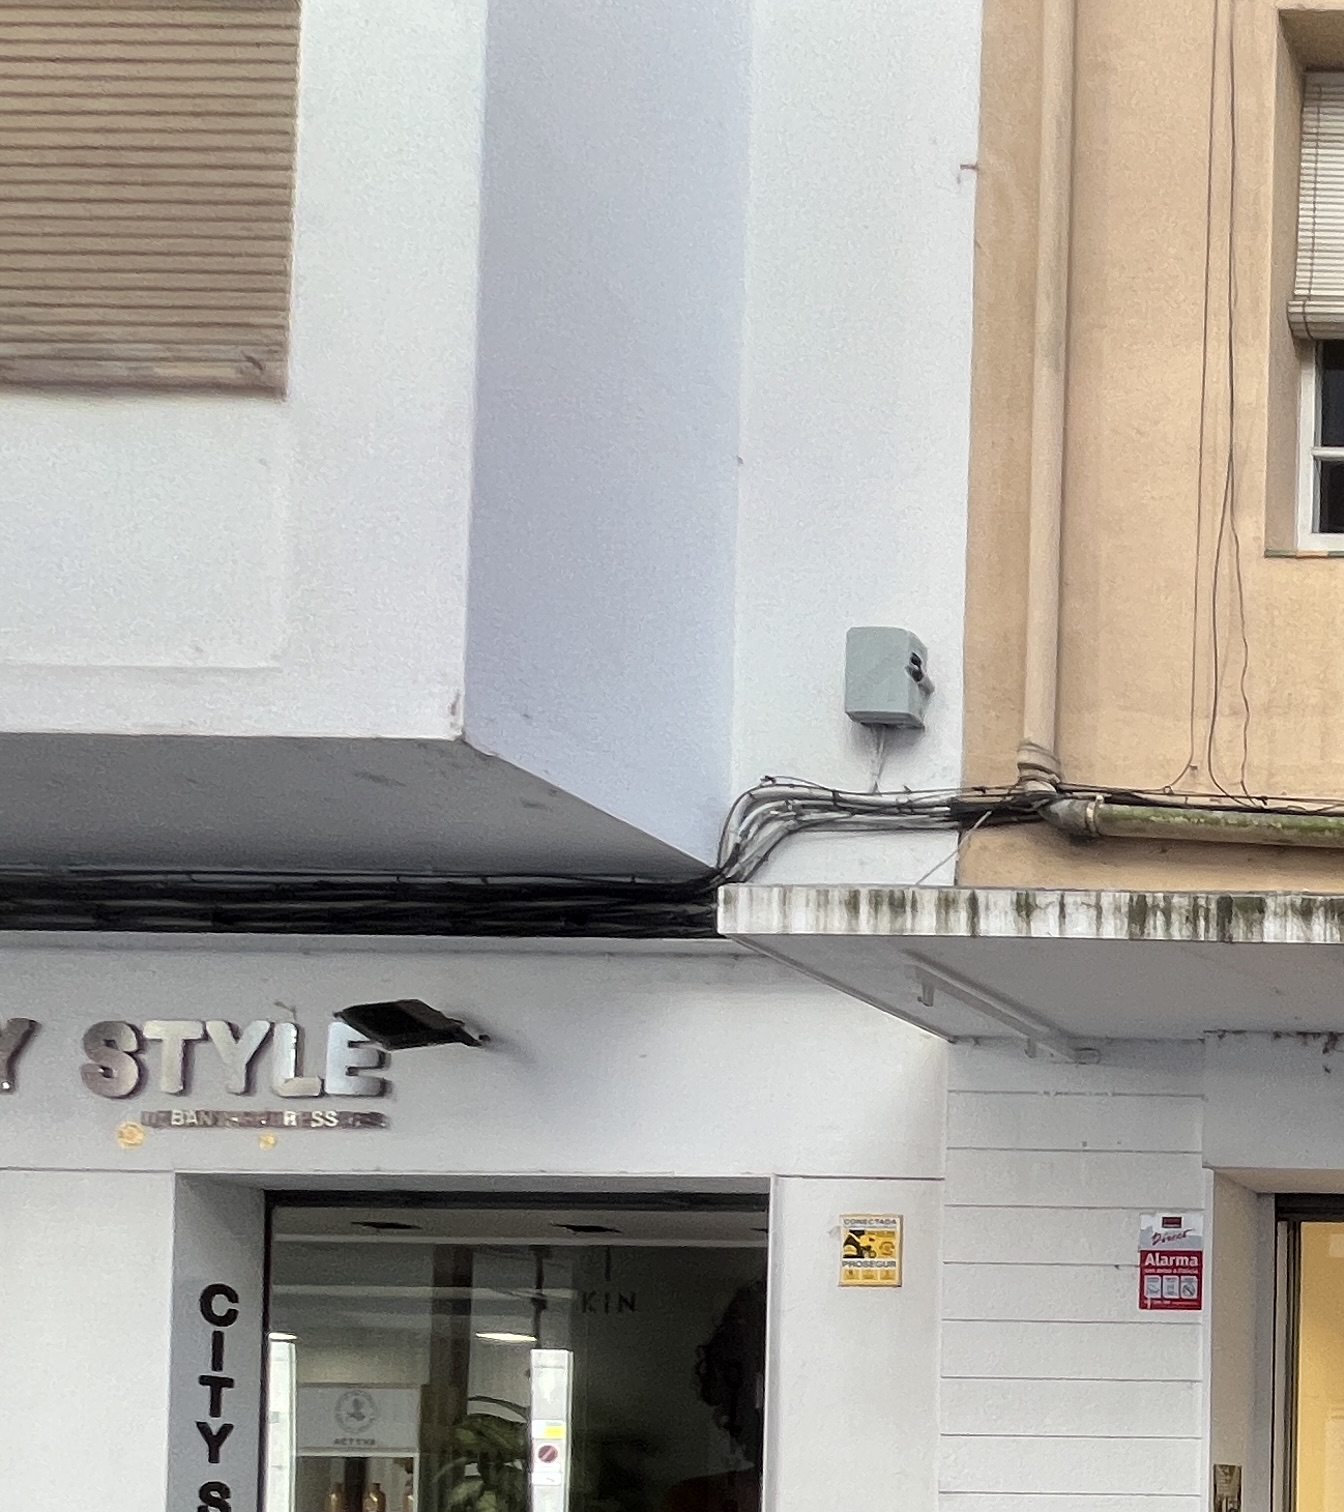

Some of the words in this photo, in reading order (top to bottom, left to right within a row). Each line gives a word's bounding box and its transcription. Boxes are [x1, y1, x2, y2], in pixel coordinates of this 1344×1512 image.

[81, 1018, 393, 1098] STYLE
[841, 1260, 896, 1268] PROSEGUR
[1145, 1252, 1198, 1267] Alarma
[196, 1283, 240, 1464] CITY
